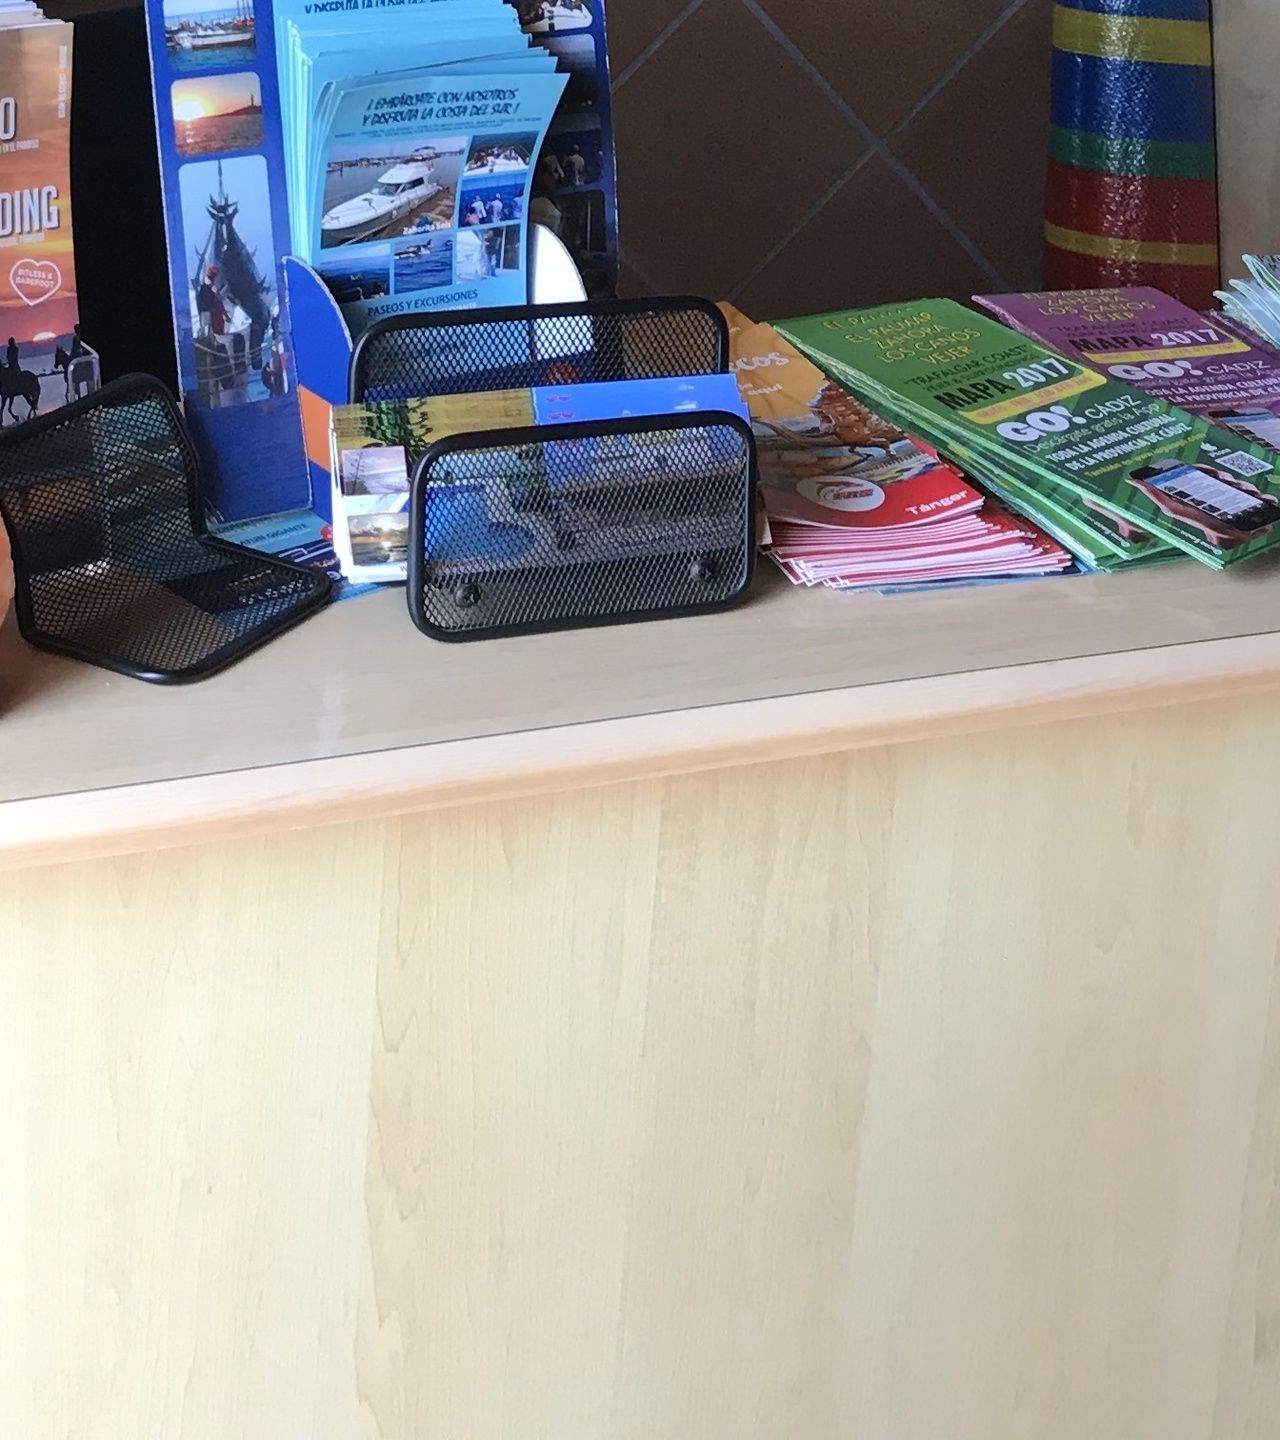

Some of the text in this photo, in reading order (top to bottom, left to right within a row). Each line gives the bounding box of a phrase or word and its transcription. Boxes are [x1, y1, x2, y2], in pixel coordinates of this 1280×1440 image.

[368, 302, 404, 317] PASEOS
[406, 300, 413, 310] Y
[415, 289, 478, 309] EXCURSIONES
[875, 324, 950, 350] ZAHORA
[1069, 335, 1152, 352] MAPA
[1150, 329, 1220, 346] 2017
[919, 346, 974, 365] VEJER
[1108, 360, 1271, 380] GO! CÁDIZ
[934, 378, 1015, 410] MAPA
[1003, 358, 1070, 388] 2017
[1184, 391, 1251, 401] PROVINCIA
[1188, 384, 1237, 394] AGENDA
[996, 405, 1087, 441] GO!
[1085, 395, 1142, 420] CÁDIZ
[1134, 402, 1161, 419] App
[1046, 449, 1077, 463] TODA
[1077, 443, 1090, 454] LA
[1090, 432, 1130, 449] AGENDA
[1126, 415, 1176, 434] CULTURAL
[1065, 422, 1192, 471] DE LA PROVINCIA DE CÁDIZ
[905, 489, 969, 515] Tánger
